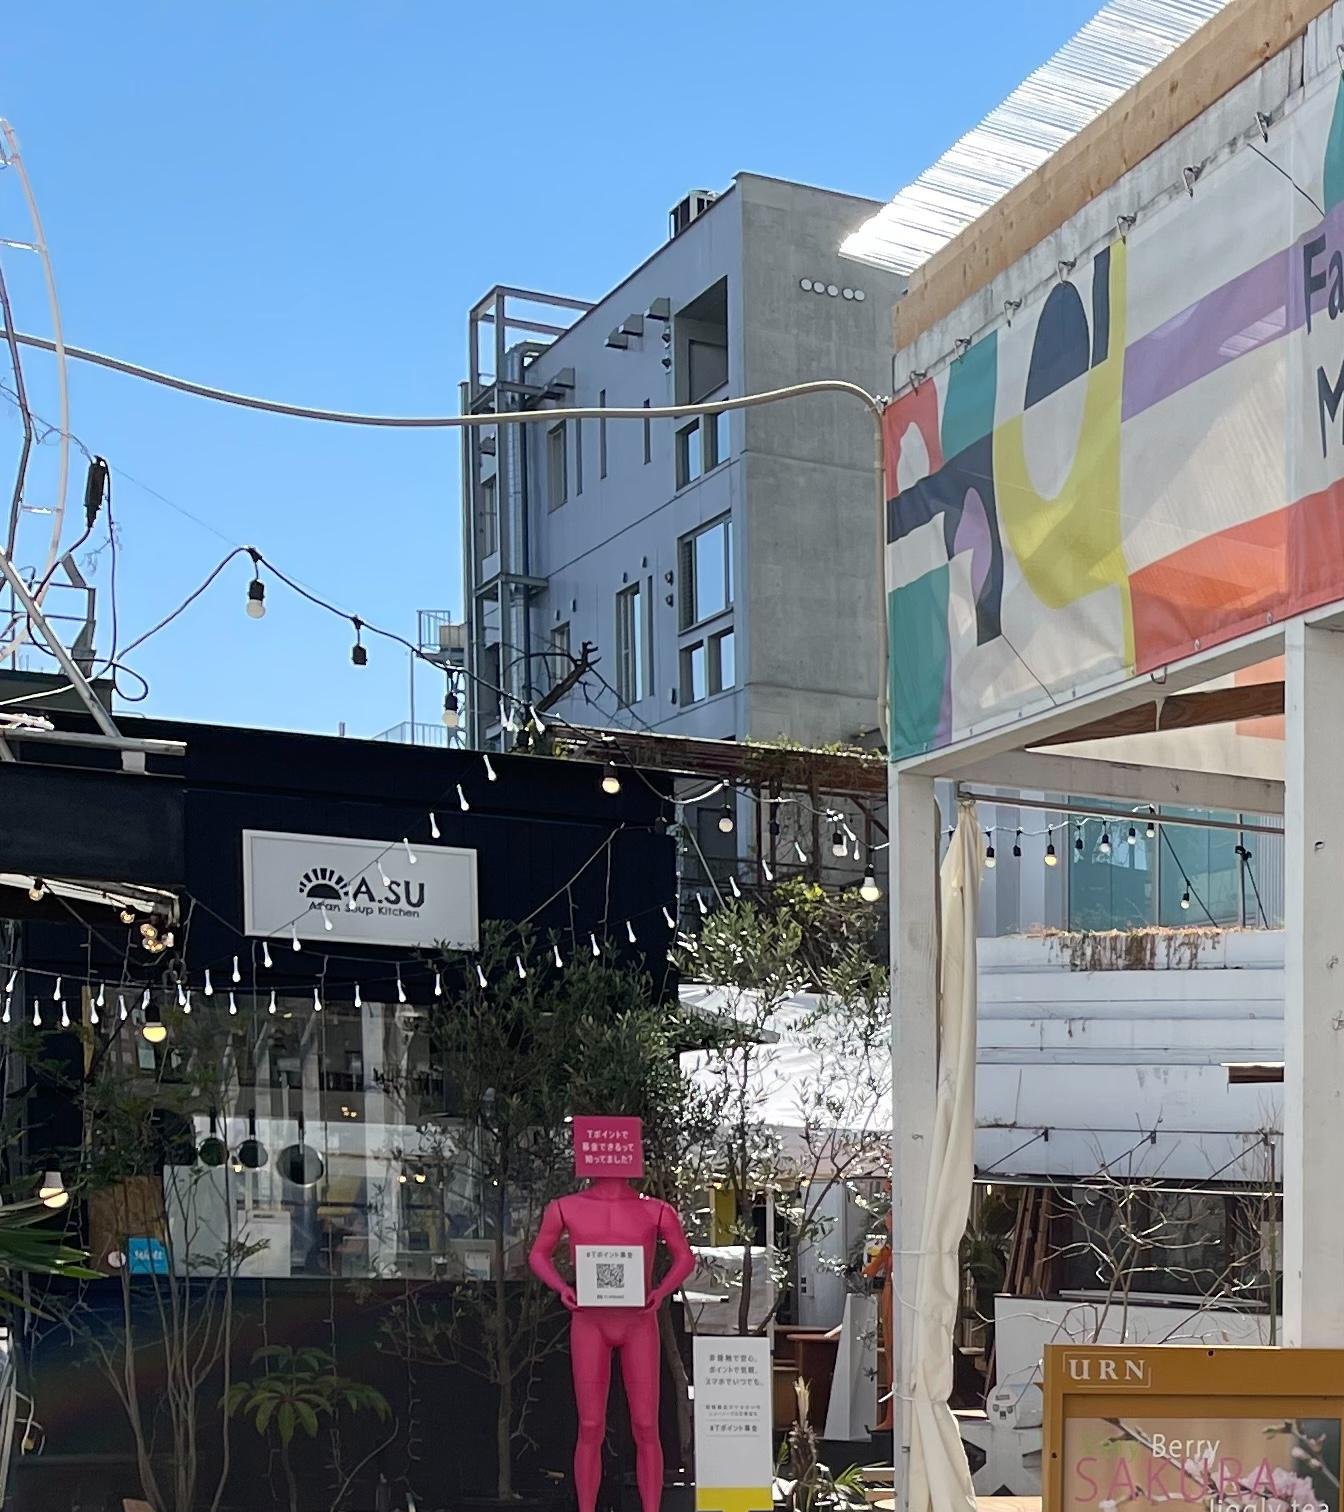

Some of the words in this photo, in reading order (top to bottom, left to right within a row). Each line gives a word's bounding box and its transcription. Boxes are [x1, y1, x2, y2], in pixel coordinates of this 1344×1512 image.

[309, 901, 340, 912] Asan
[345, 902, 374, 915] Sup
[378, 906, 420, 918] Kitchen
[1069, 1359, 1145, 1381] URN
[1151, 1433, 1221, 1464] Berry
[1074, 1457, 1281, 1504] SAKURA
